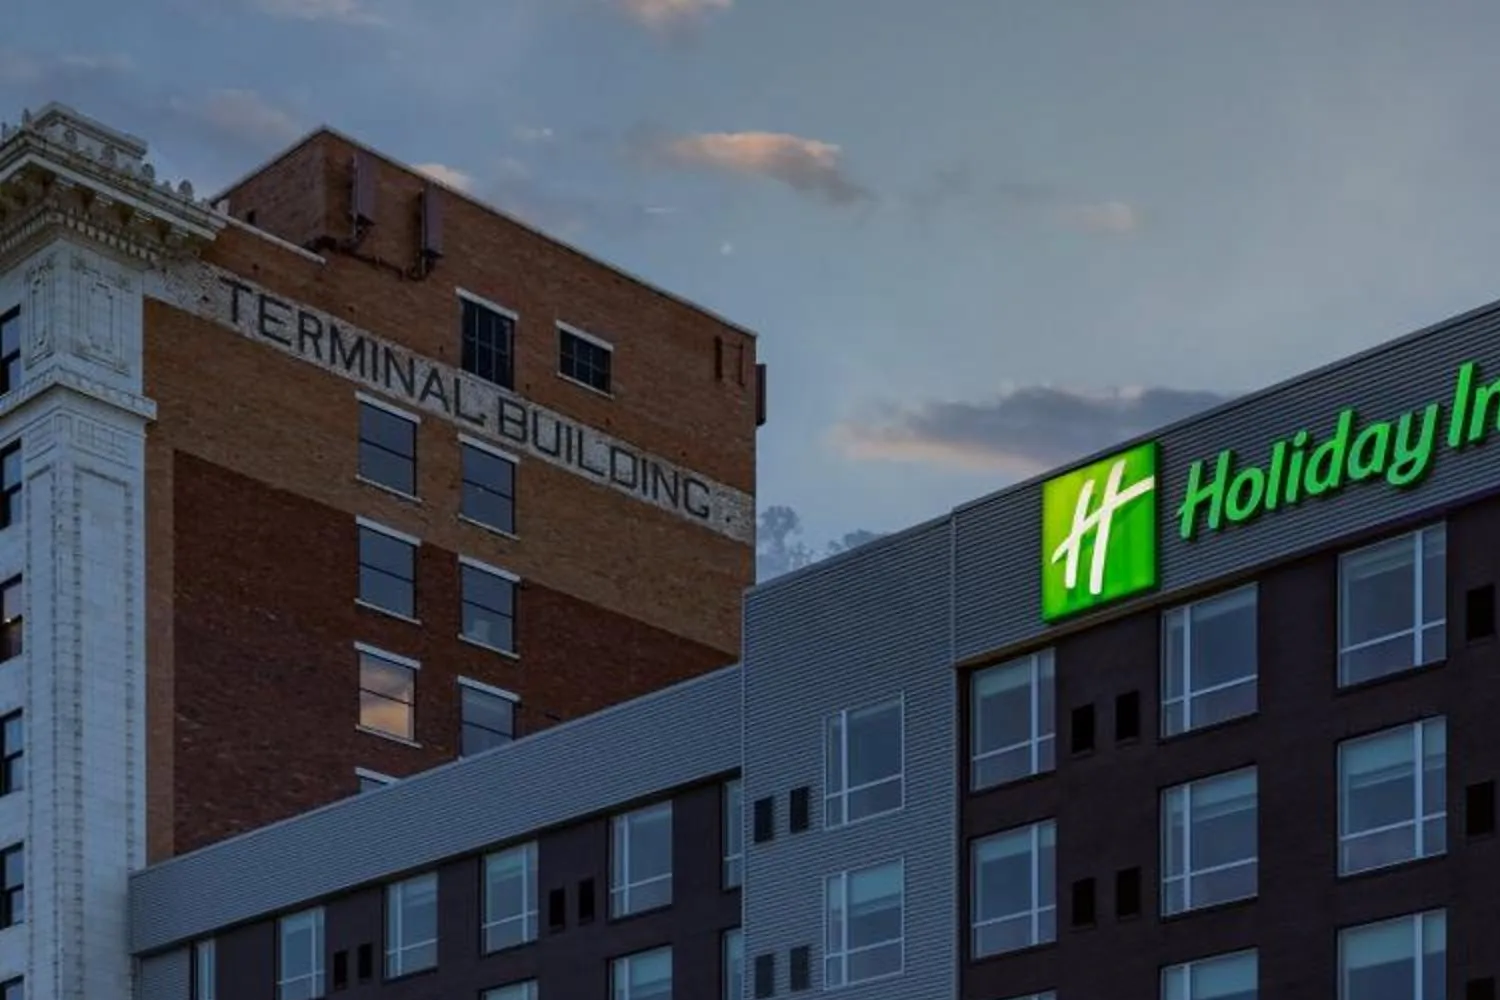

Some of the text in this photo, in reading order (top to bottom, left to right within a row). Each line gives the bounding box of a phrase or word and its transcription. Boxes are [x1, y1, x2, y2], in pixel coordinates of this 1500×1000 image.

[220, 276, 712, 522] TERMINAL BUILDING
[1177, 403, 1439, 539] Holiday
